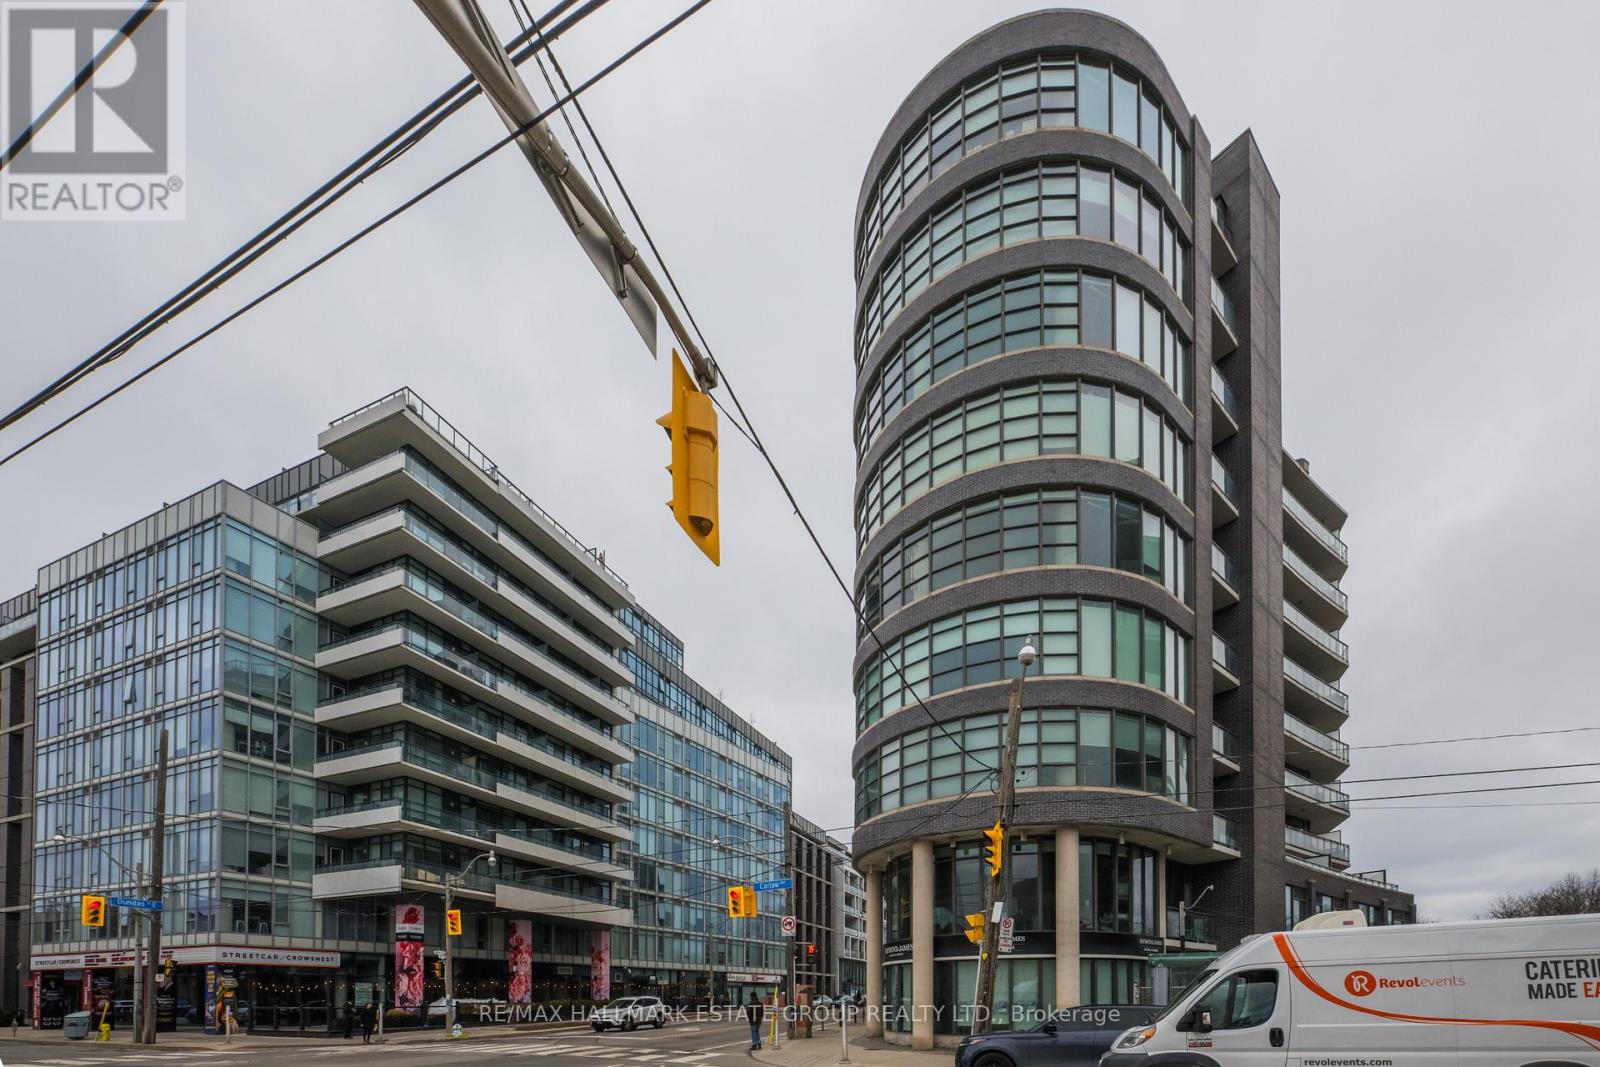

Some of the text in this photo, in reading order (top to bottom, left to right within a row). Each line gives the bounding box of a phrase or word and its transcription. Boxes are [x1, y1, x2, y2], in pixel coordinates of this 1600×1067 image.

[117, 898, 145, 907] Dundas
[1525, 959, 1600, 980] CATERI
[1379, 975, 1466, 988] Revolevents
[1528, 982, 1578, 999] MADE
[1304, 1058, 1392, 1067] revolevents.com
